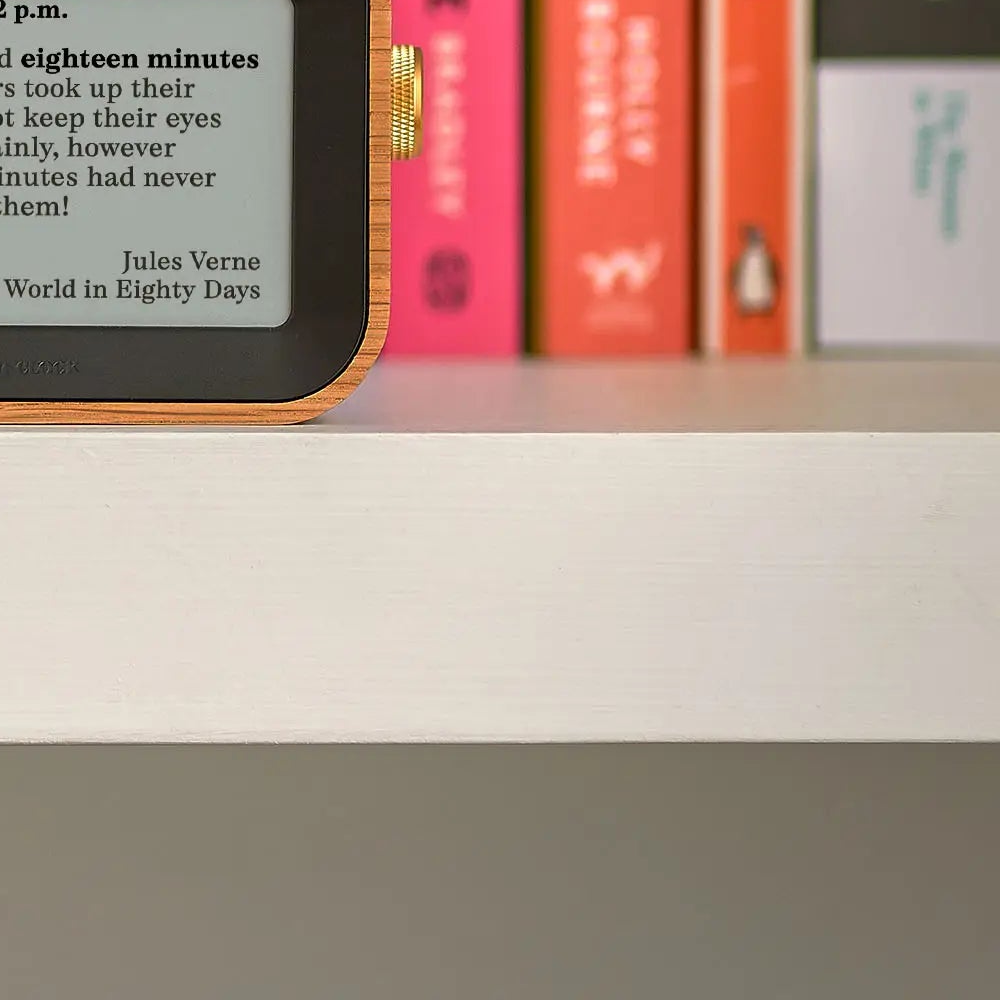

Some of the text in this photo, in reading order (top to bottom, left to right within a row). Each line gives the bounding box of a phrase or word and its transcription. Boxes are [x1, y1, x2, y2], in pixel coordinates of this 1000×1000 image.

[13, 4, 68, 25] p.m.
[20, 47, 140, 75] eighteen
[146, 47, 260, 70] minutes
[23, 76, 82, 98] took
[88, 82, 123, 104] up
[130, 76, 196, 99] their
[23, 105, 85, 134] keep
[92, 106, 158, 128] their
[165, 112, 222, 134] eyes
[66, 135, 176, 158] however
[86, 165, 136, 188] had
[143, 171, 217, 188] never
[120, 250, 261, 275] Jules Verne
[3, 278, 77, 299] World
[83, 279, 108, 299] in
[115, 278, 197, 305] Eighty
[203, 279, 261, 305] Days
